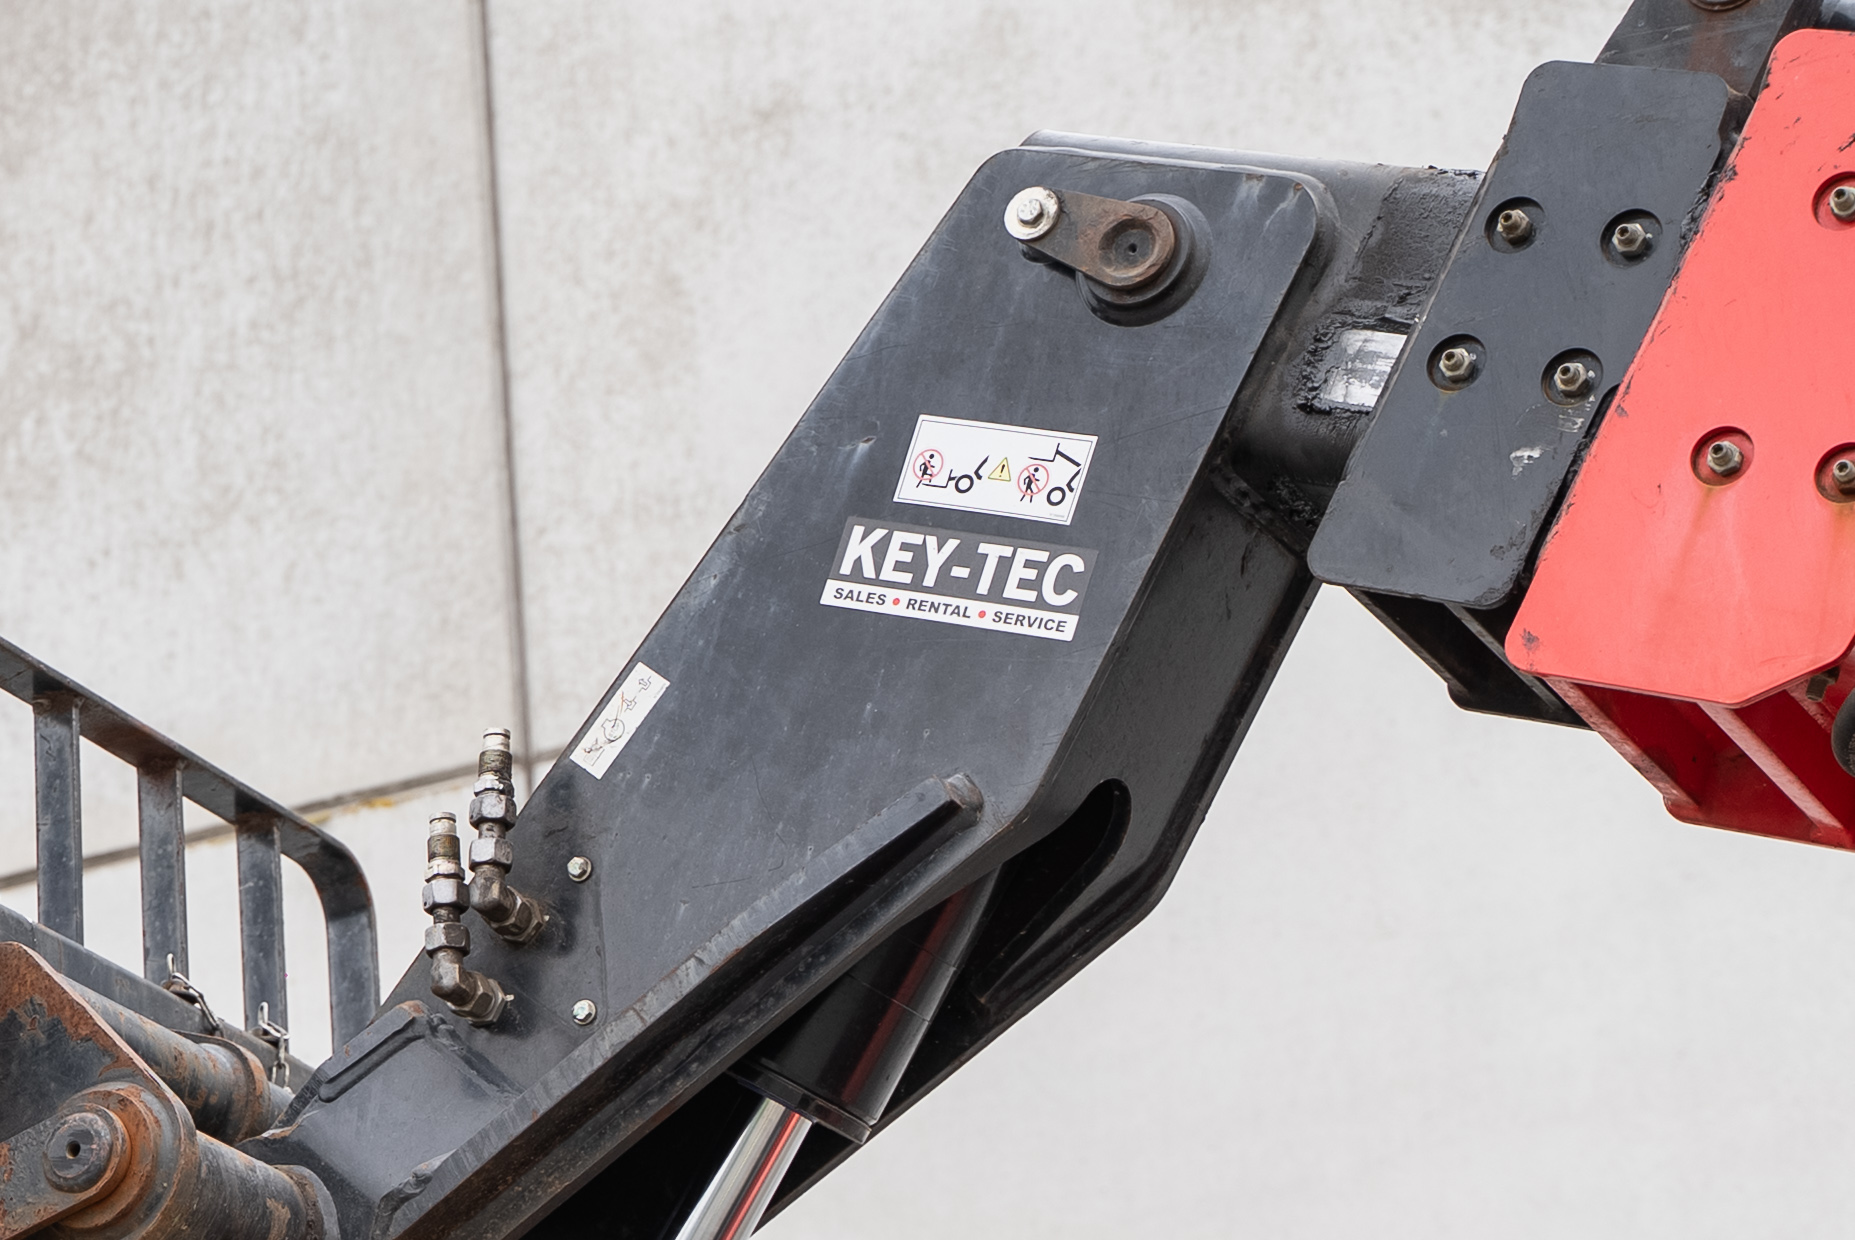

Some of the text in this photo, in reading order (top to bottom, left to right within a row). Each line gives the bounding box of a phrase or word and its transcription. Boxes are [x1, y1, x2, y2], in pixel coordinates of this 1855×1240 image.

[839, 525, 1085, 606] KEY-TEC
[834, 588, 1068, 633] SALES RENTAL SERVICE
